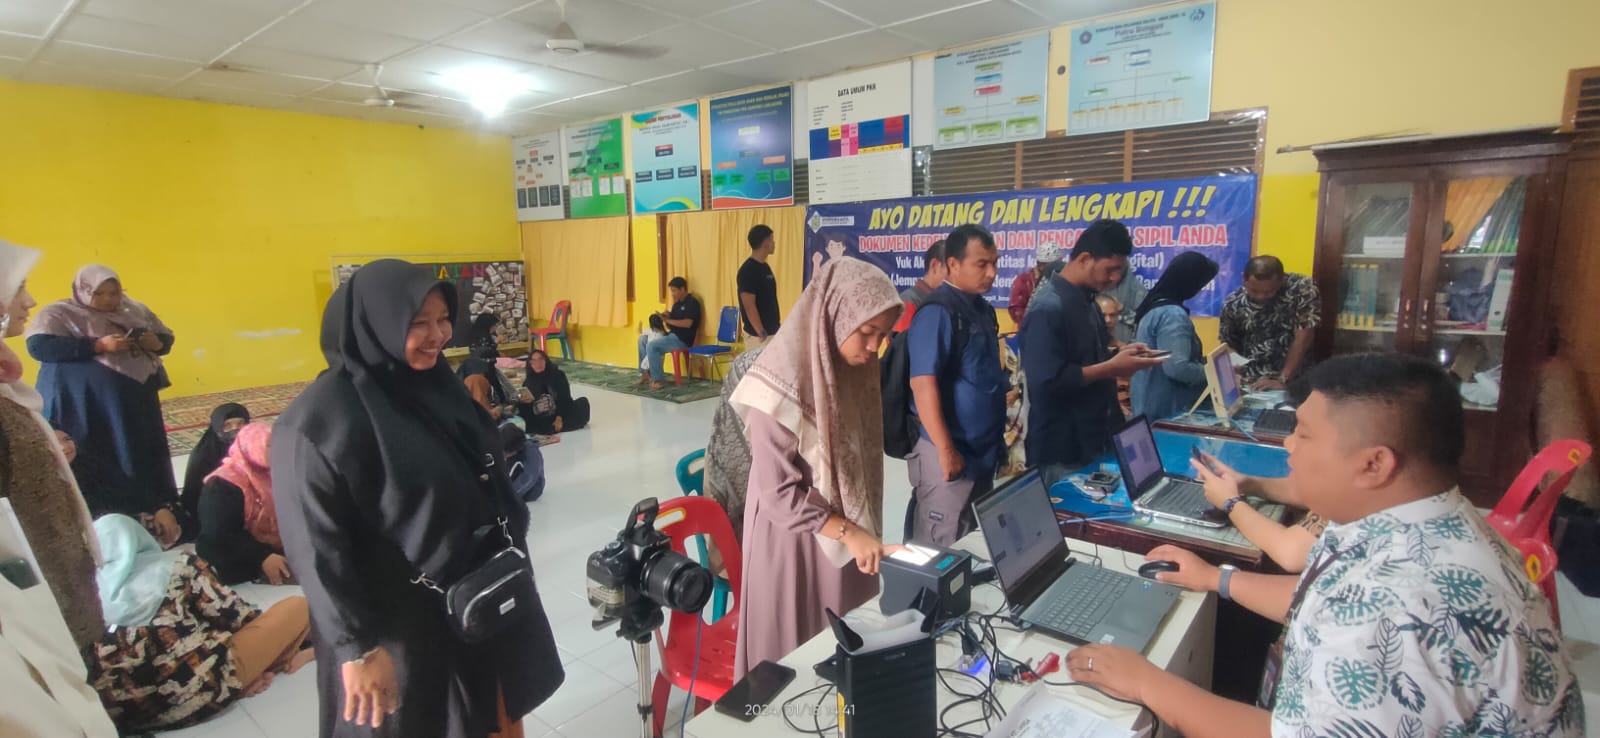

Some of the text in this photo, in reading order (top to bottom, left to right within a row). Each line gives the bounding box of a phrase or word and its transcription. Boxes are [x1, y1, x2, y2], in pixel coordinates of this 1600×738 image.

[868, 186, 1216, 230] AYO DATANG DAN LENGKAPI !!!
[859, 234, 911, 253] DOKUMEN
[1007, 230, 1036, 250] DAN
[1133, 226, 1174, 248] SIPIL
[1177, 224, 1228, 246] ANDA
[895, 256, 912, 270] Yuk
